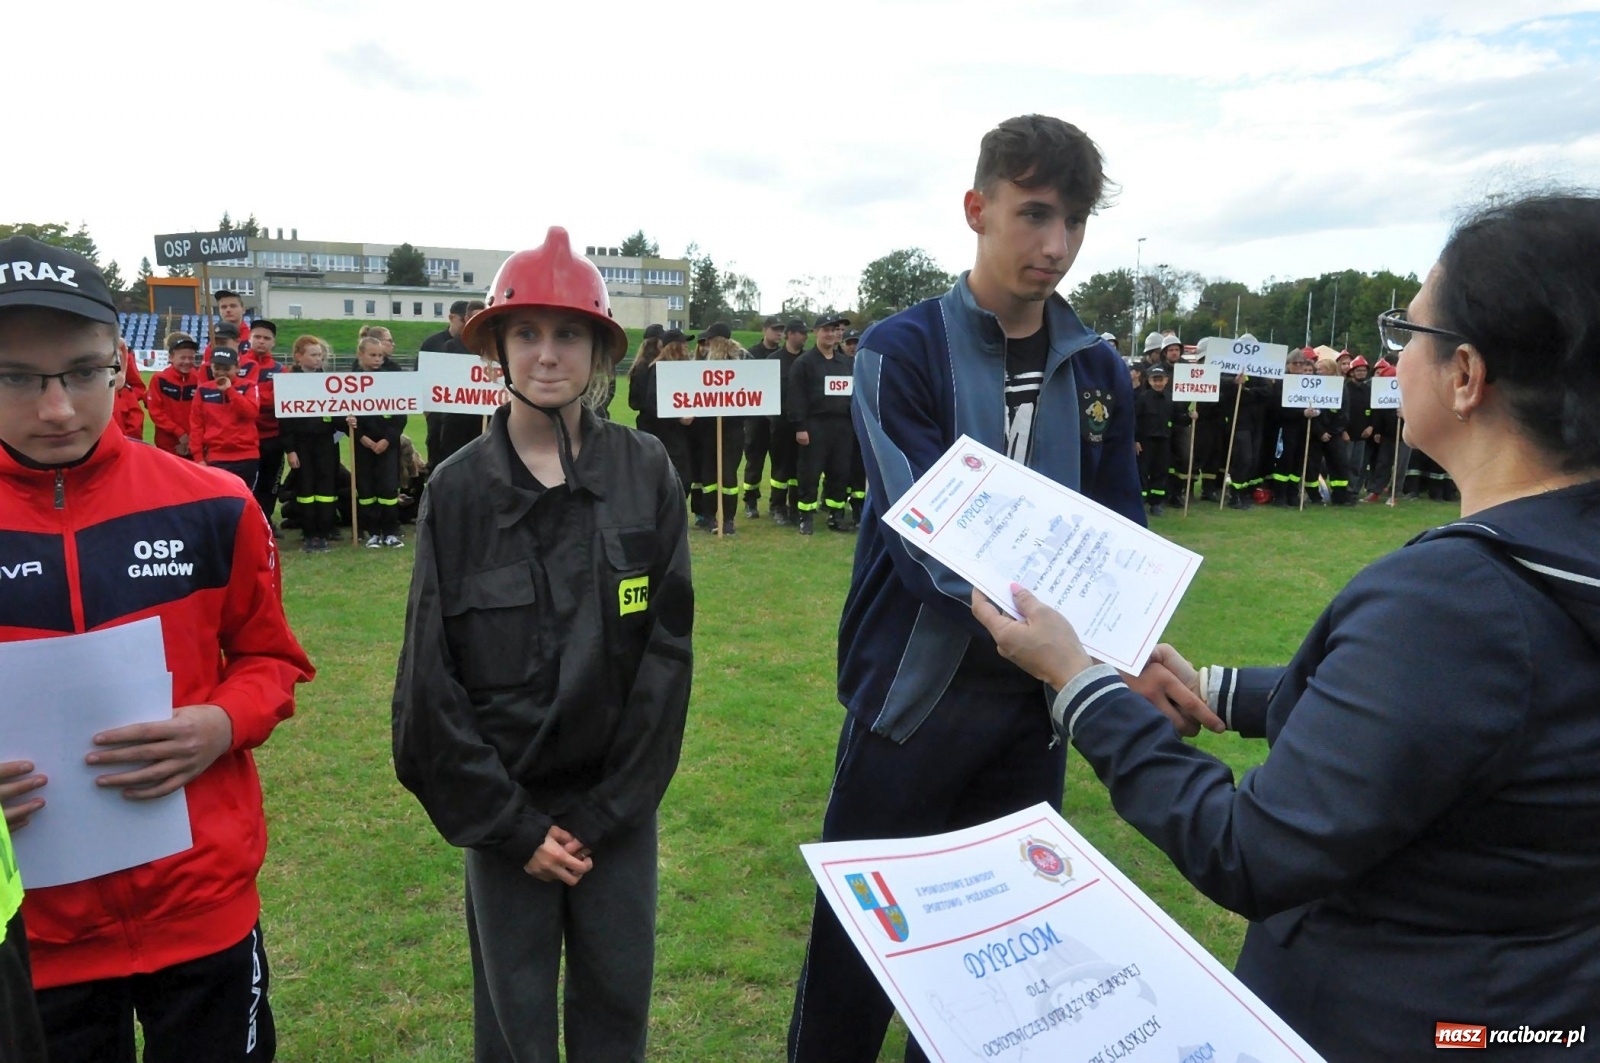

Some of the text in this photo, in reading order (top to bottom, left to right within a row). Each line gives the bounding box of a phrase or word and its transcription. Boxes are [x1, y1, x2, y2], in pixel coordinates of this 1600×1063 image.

[164, 240, 191, 258] OSP
[1232, 342, 1261, 355] OSP
[702, 369, 736, 387] OSP
[1190, 368, 1205, 379] OSP
[1246, 362, 1283, 377] ŚLĄSKIE
[325, 375, 375, 394] OSP
[829, 380, 849, 391] OSP
[1300, 377, 1322, 389] OSP
[281, 396, 417, 414] KRZYŻANOWICE
[672, 387, 763, 408] SŁAWIKÓW
[133, 540, 185, 560] OSP
[128, 559, 194, 578] GAMÓW
[623, 586, 648, 605] STR
[963, 921, 1063, 979] DYPLOM
[1026, 978, 1051, 998] DLA
[982, 963, 1141, 1057] OCHOTNICZEJ STRAŻY POŻARNEJ
